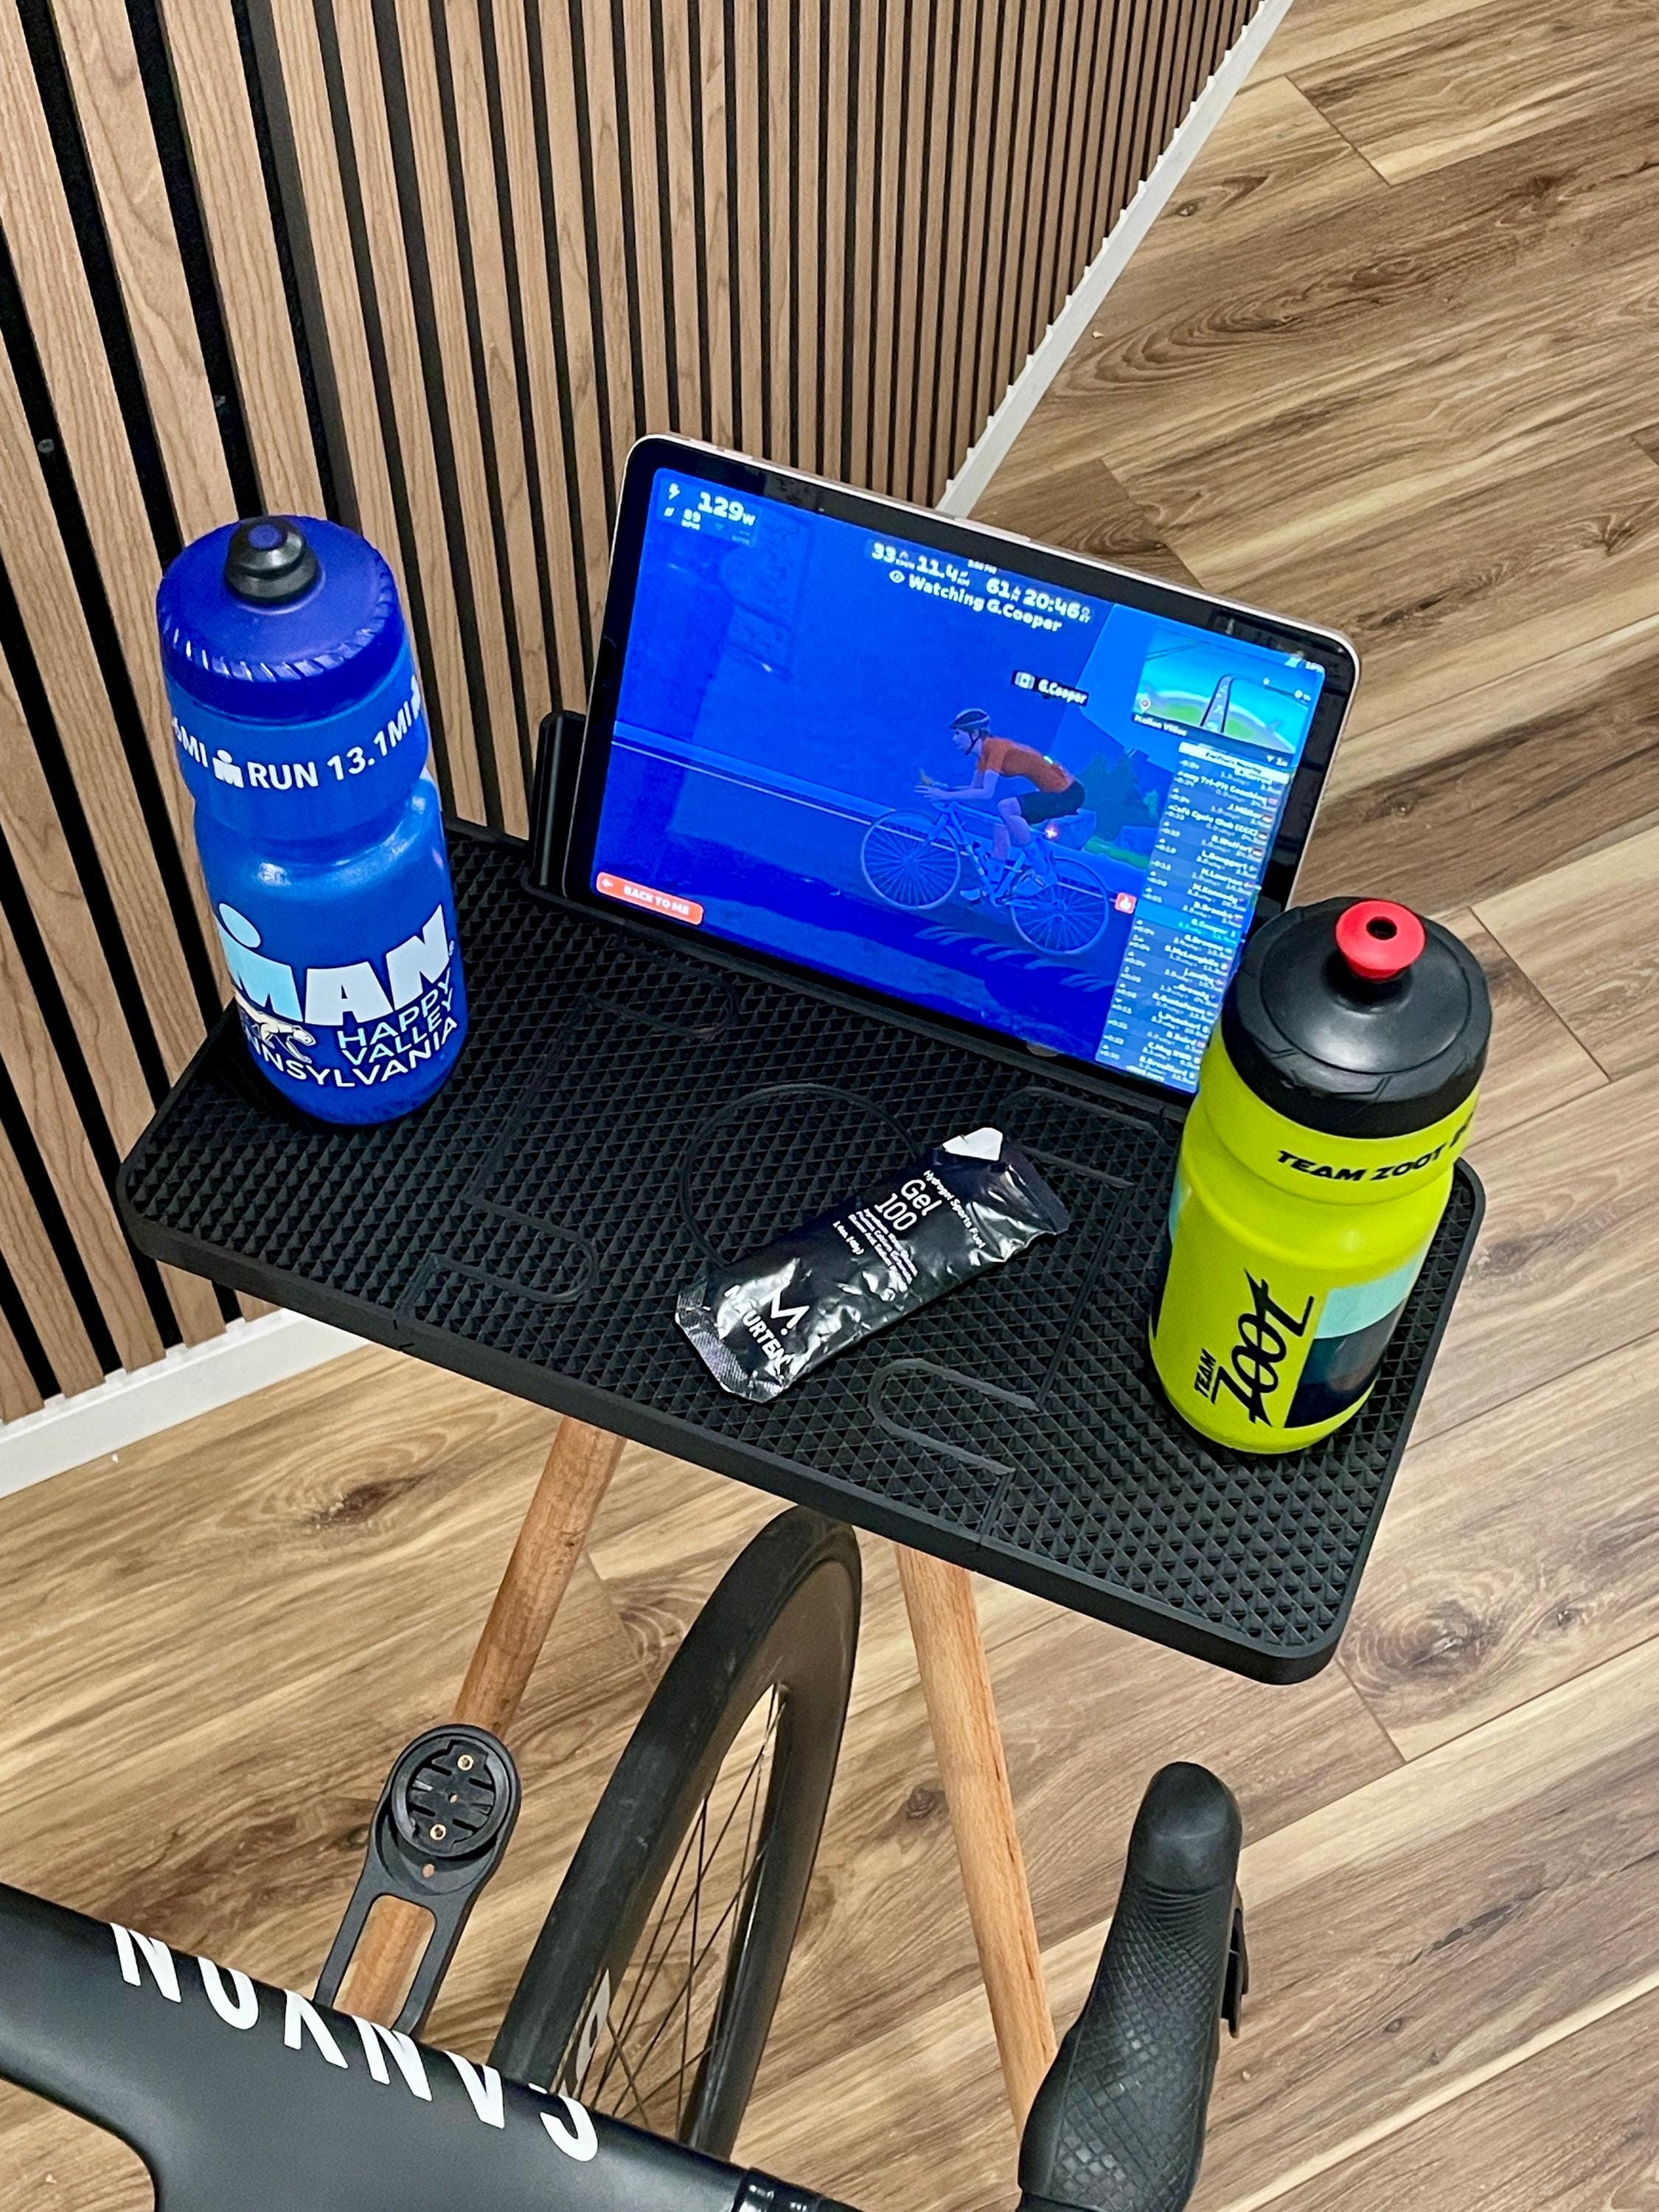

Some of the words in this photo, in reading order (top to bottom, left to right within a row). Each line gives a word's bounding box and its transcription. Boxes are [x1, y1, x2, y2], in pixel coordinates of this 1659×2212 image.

[872, 543, 896, 563] 33
[917, 555, 959, 582] 11.4
[987, 578, 1010, 599] 61
[1023, 588, 1081, 619] 20:46
[909, 574, 984, 611] Watching
[987, 599, 1062, 631] G.Cooper
[248, 761, 319, 790] RUN
[624, 886, 653, 902] BACK
[655, 896, 671, 908] TO
[672, 903, 690, 915] ME
[337, 967, 451, 1048] HAPPY
[342, 988, 453, 1065] VALLEY
[1278, 1150, 1367, 1181] TEAM
[1370, 1142, 1447, 1180] ZOOT
[874, 1192, 918, 1231] 100
[900, 1179, 942, 1216] Gel
[923, 1170, 954, 1200] Hydrogel
[950, 1198, 972, 1228] Sports
[970, 1226, 986, 1248] Fuel
[1194, 1348, 1217, 1398] TEAM
[1211, 1267, 1315, 1427] ZOOT
